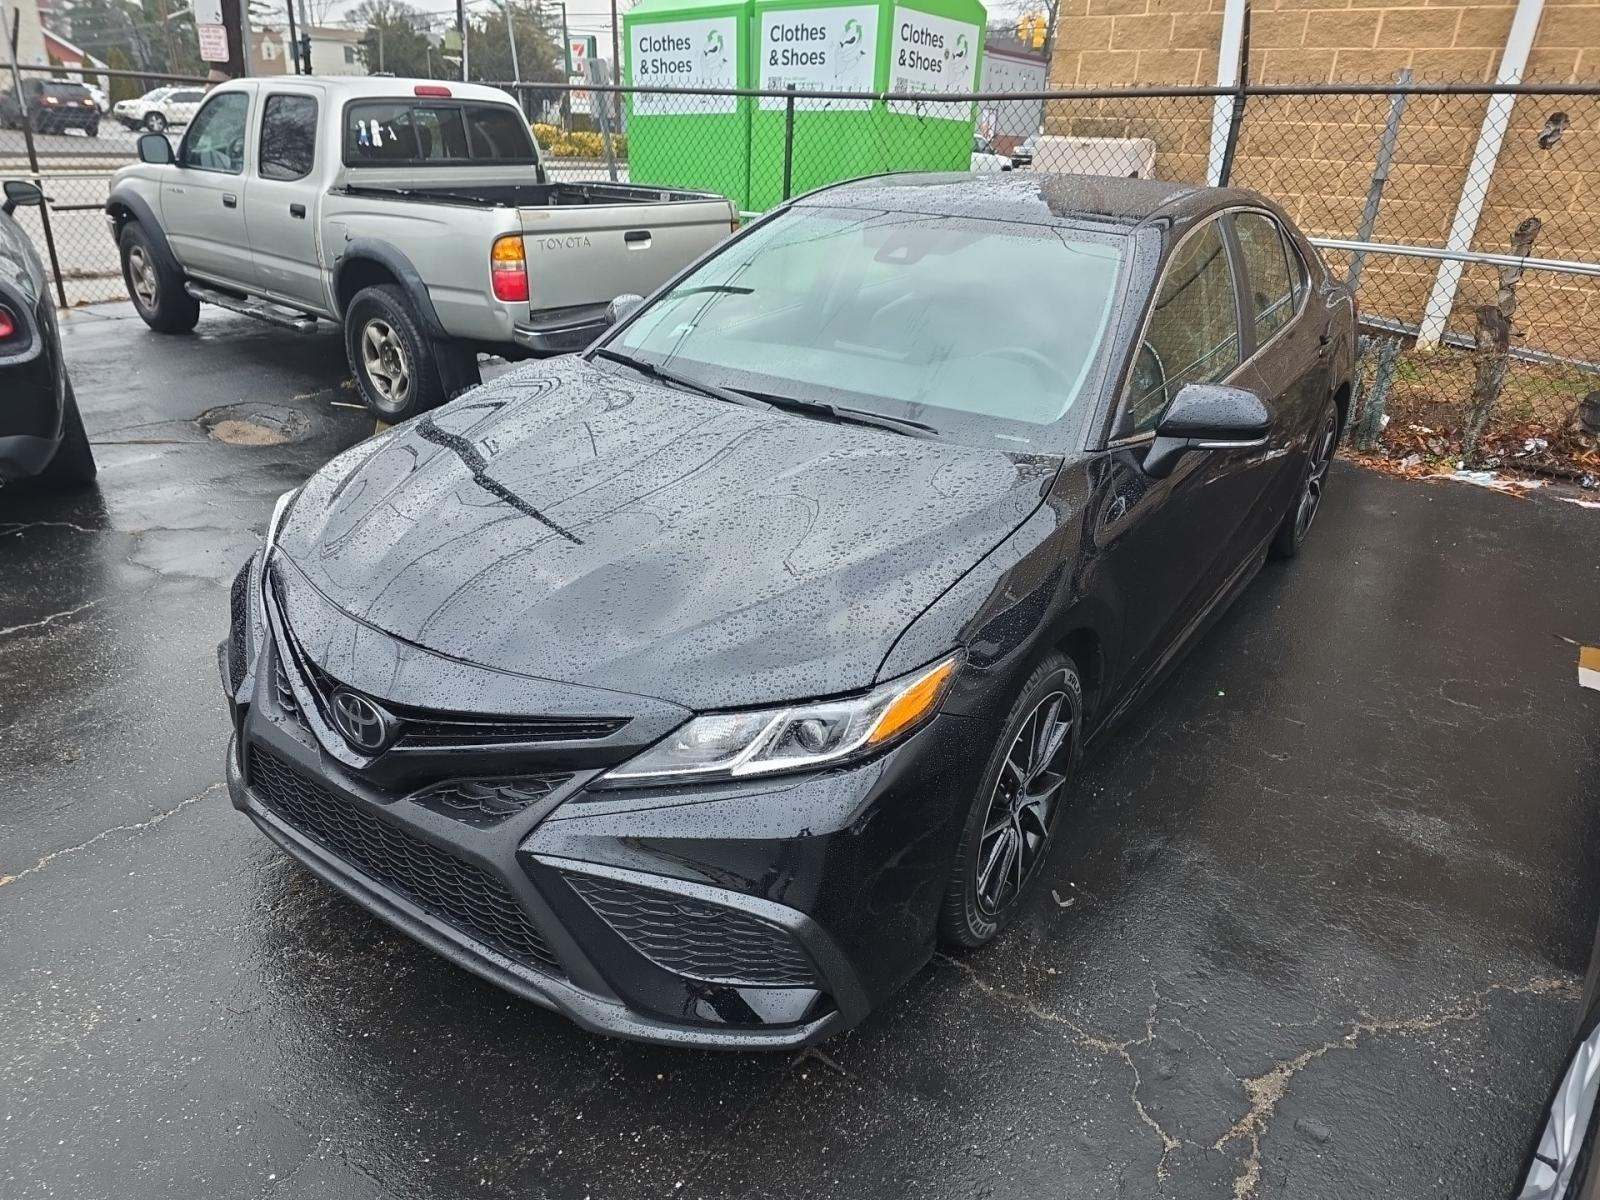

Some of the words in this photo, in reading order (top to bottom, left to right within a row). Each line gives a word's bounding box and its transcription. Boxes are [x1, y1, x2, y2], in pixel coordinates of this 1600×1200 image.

[770, 23, 826, 42] Clothes
[901, 23, 944, 48] Clothes
[639, 35, 691, 53] Clothes
[640, 59, 649, 75] &
[651, 57, 692, 75] Shoes
[769, 49, 779, 66] &
[781, 48, 826, 66] Shoes
[898, 48, 907, 67] &
[908, 50, 942, 73] Shoes
[537, 236, 591, 251] TOYOTA
